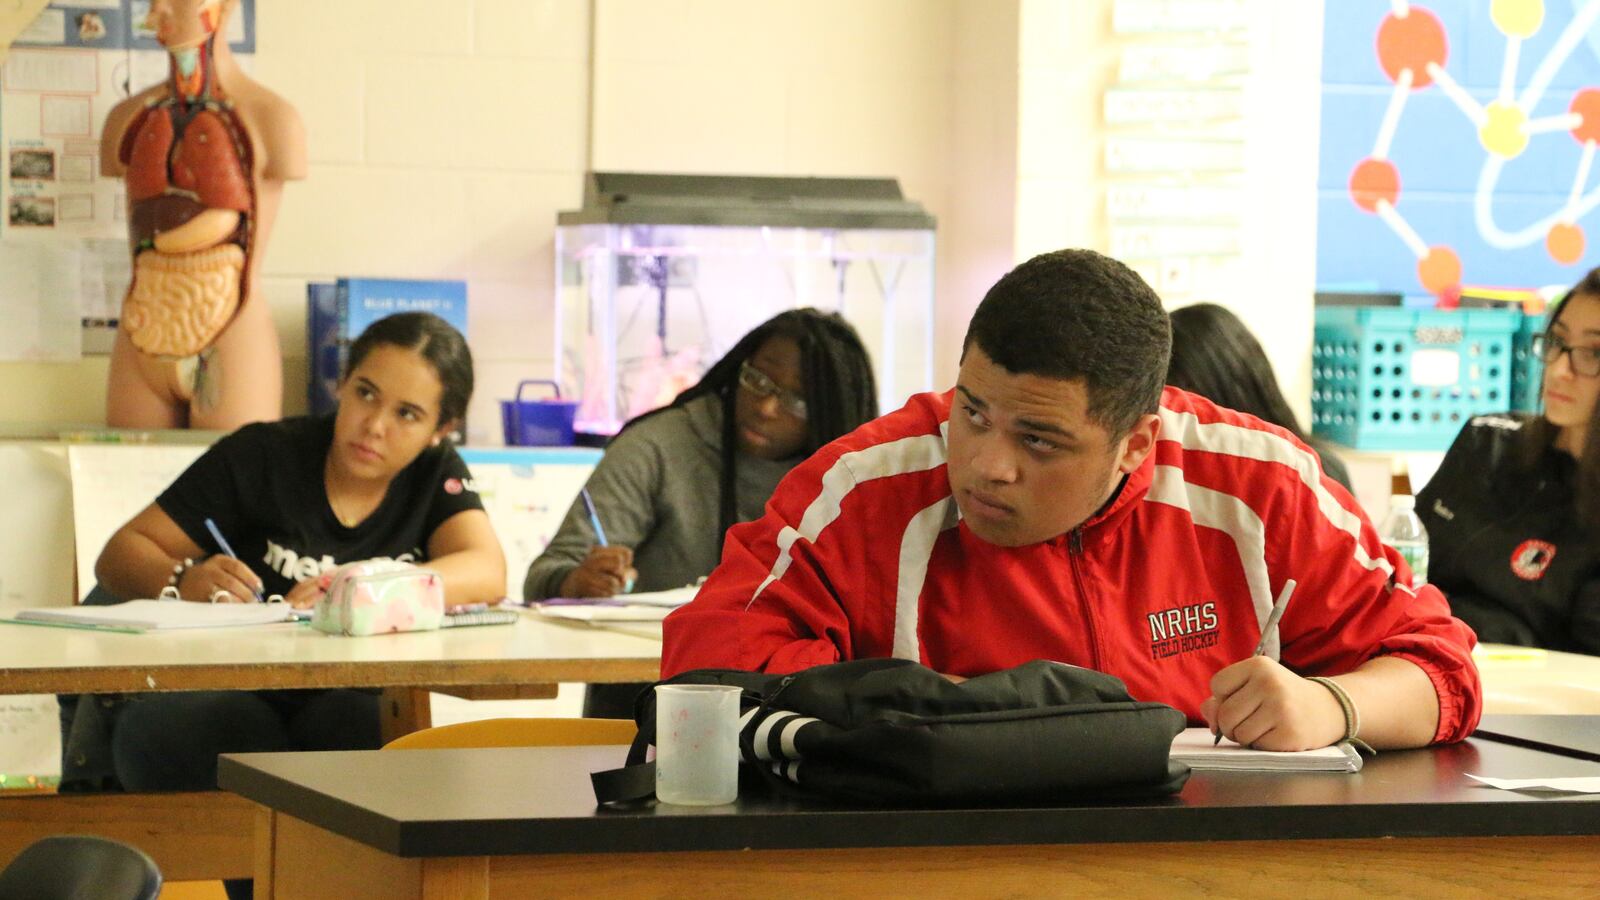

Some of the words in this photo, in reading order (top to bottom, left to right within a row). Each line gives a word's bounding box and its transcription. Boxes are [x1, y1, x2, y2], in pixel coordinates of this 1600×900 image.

[363, 298, 393, 309] BLUE
[398, 299, 439, 310] PLANET
[1148, 602, 1218, 642] NRHS
[1152, 641, 1179, 659] FIELD
[1181, 631, 1219, 652] HOCKEY
